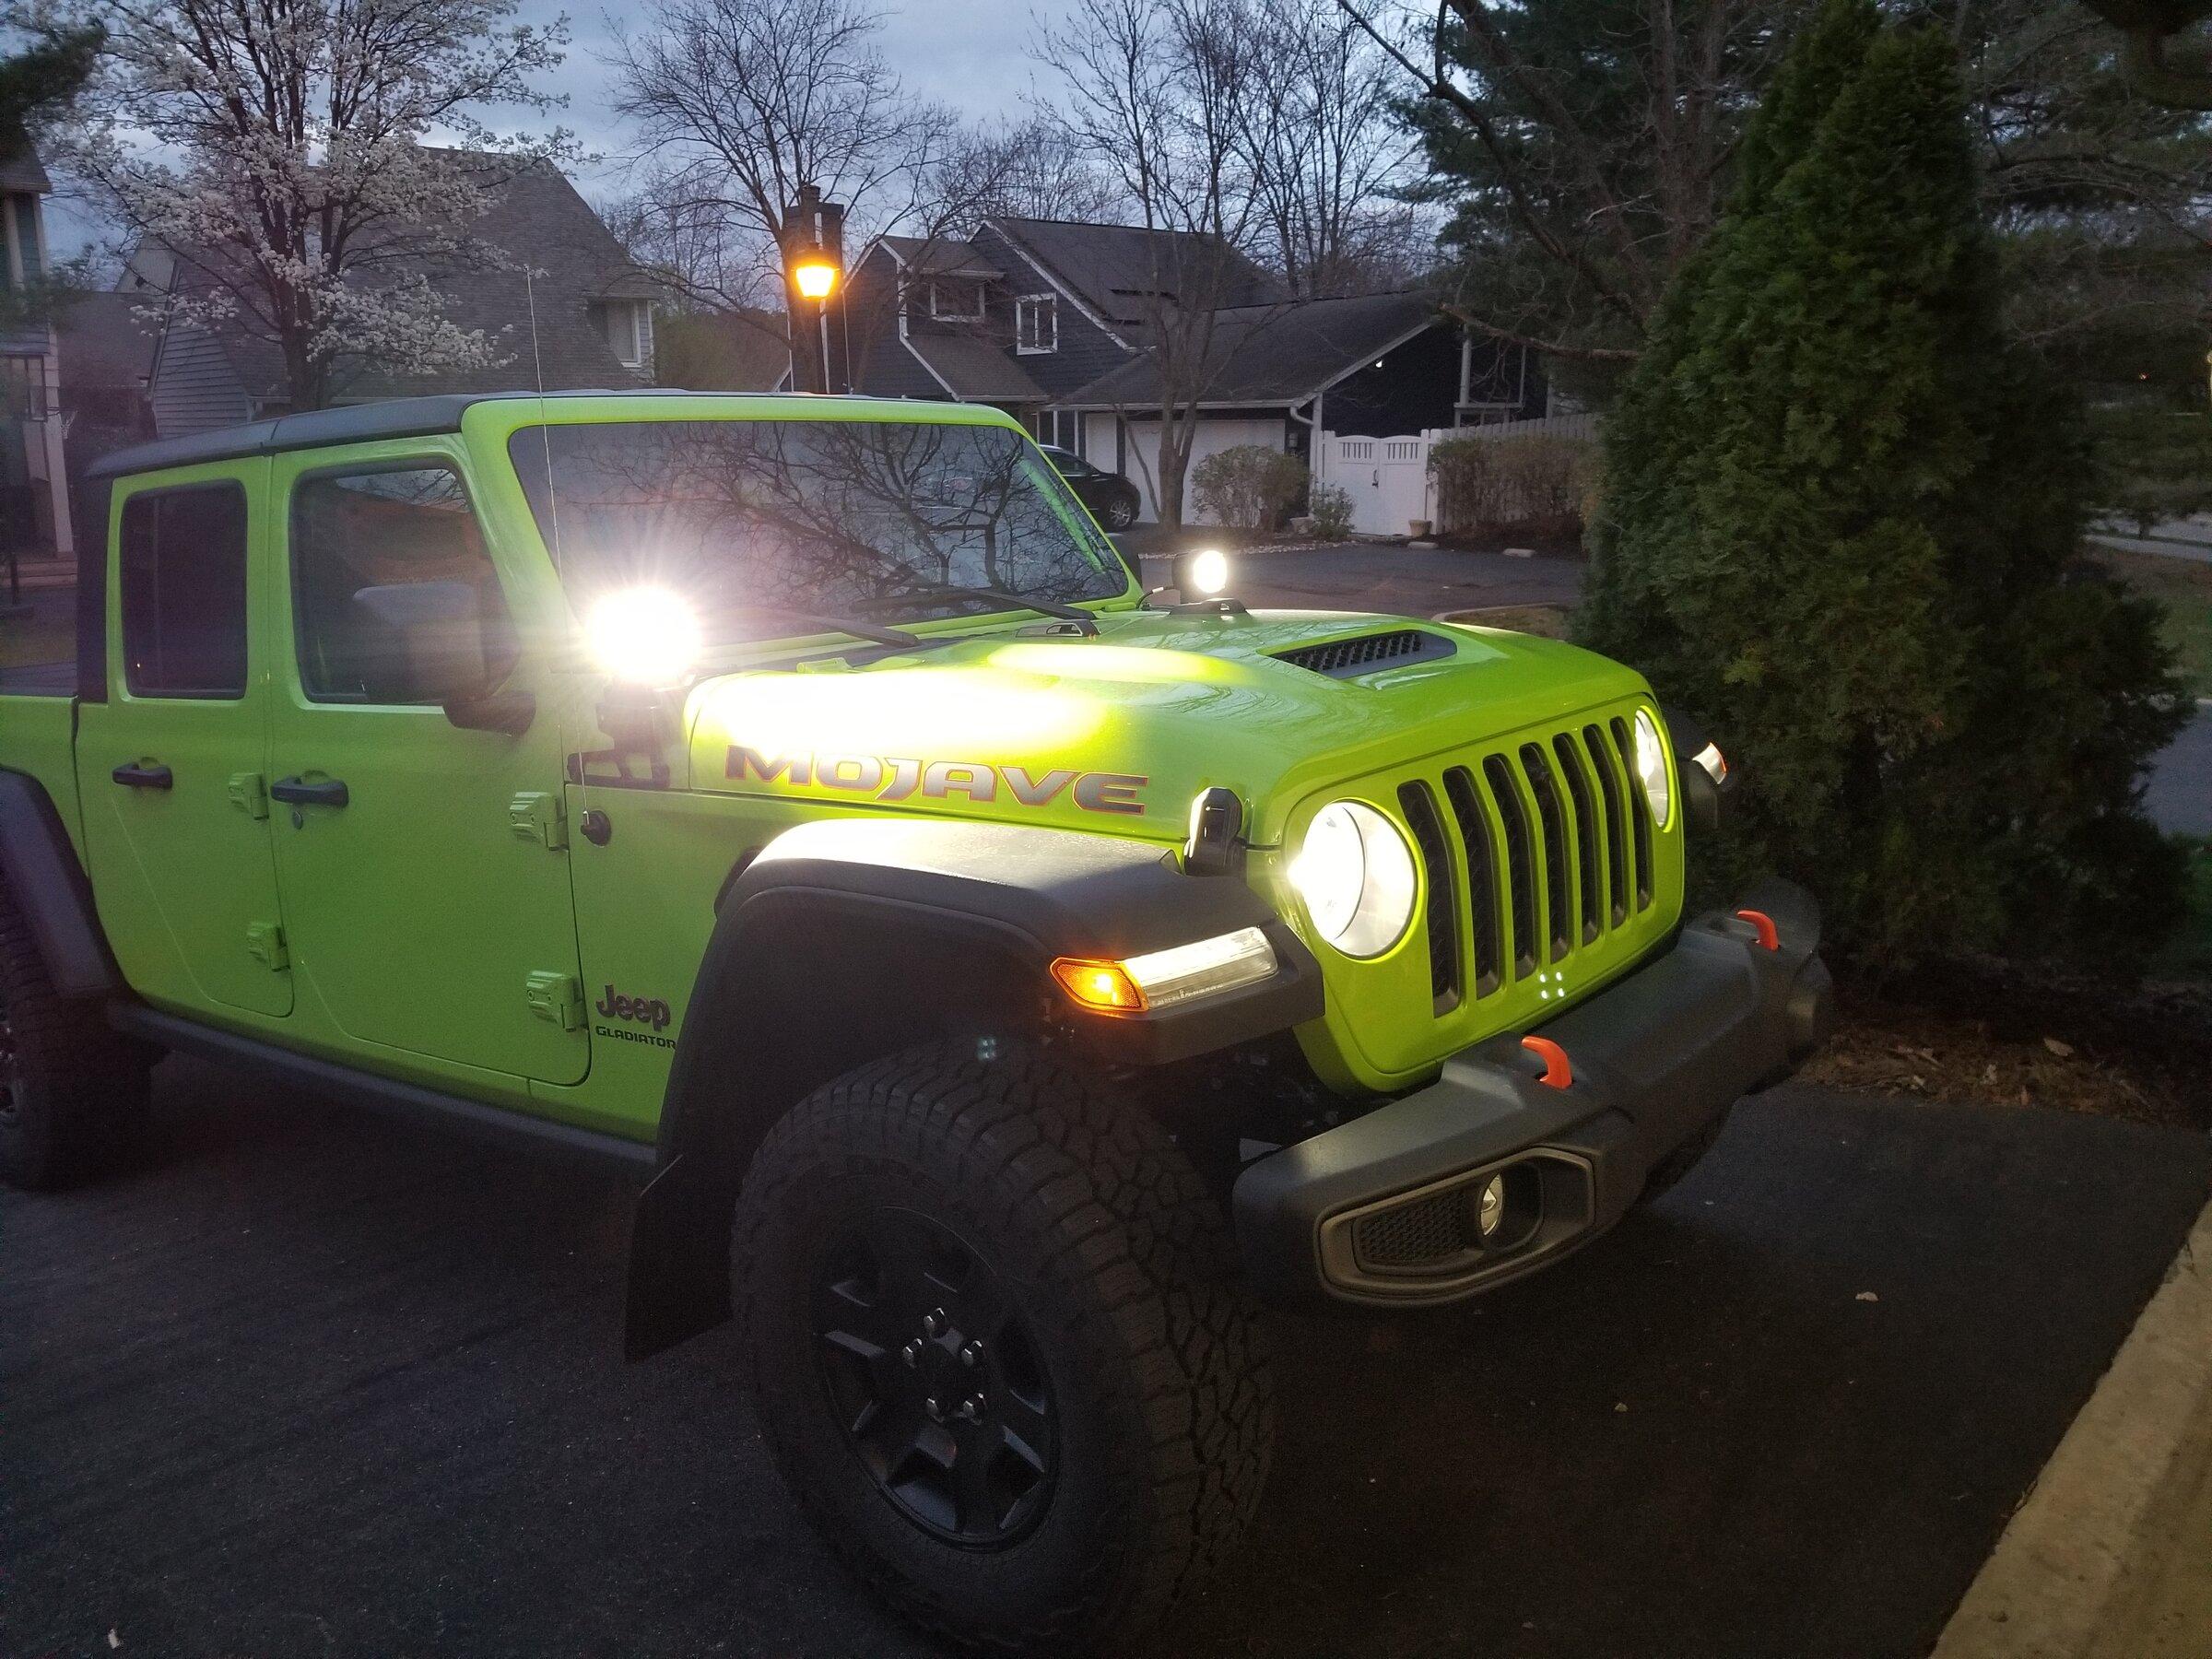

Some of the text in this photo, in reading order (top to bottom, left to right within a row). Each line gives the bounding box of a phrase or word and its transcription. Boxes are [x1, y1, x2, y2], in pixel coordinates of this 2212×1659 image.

[725, 744, 1149, 816] MOJAVE
[595, 983, 671, 1032] Jeep
[595, 1025, 677, 1050] GLADIATOR
